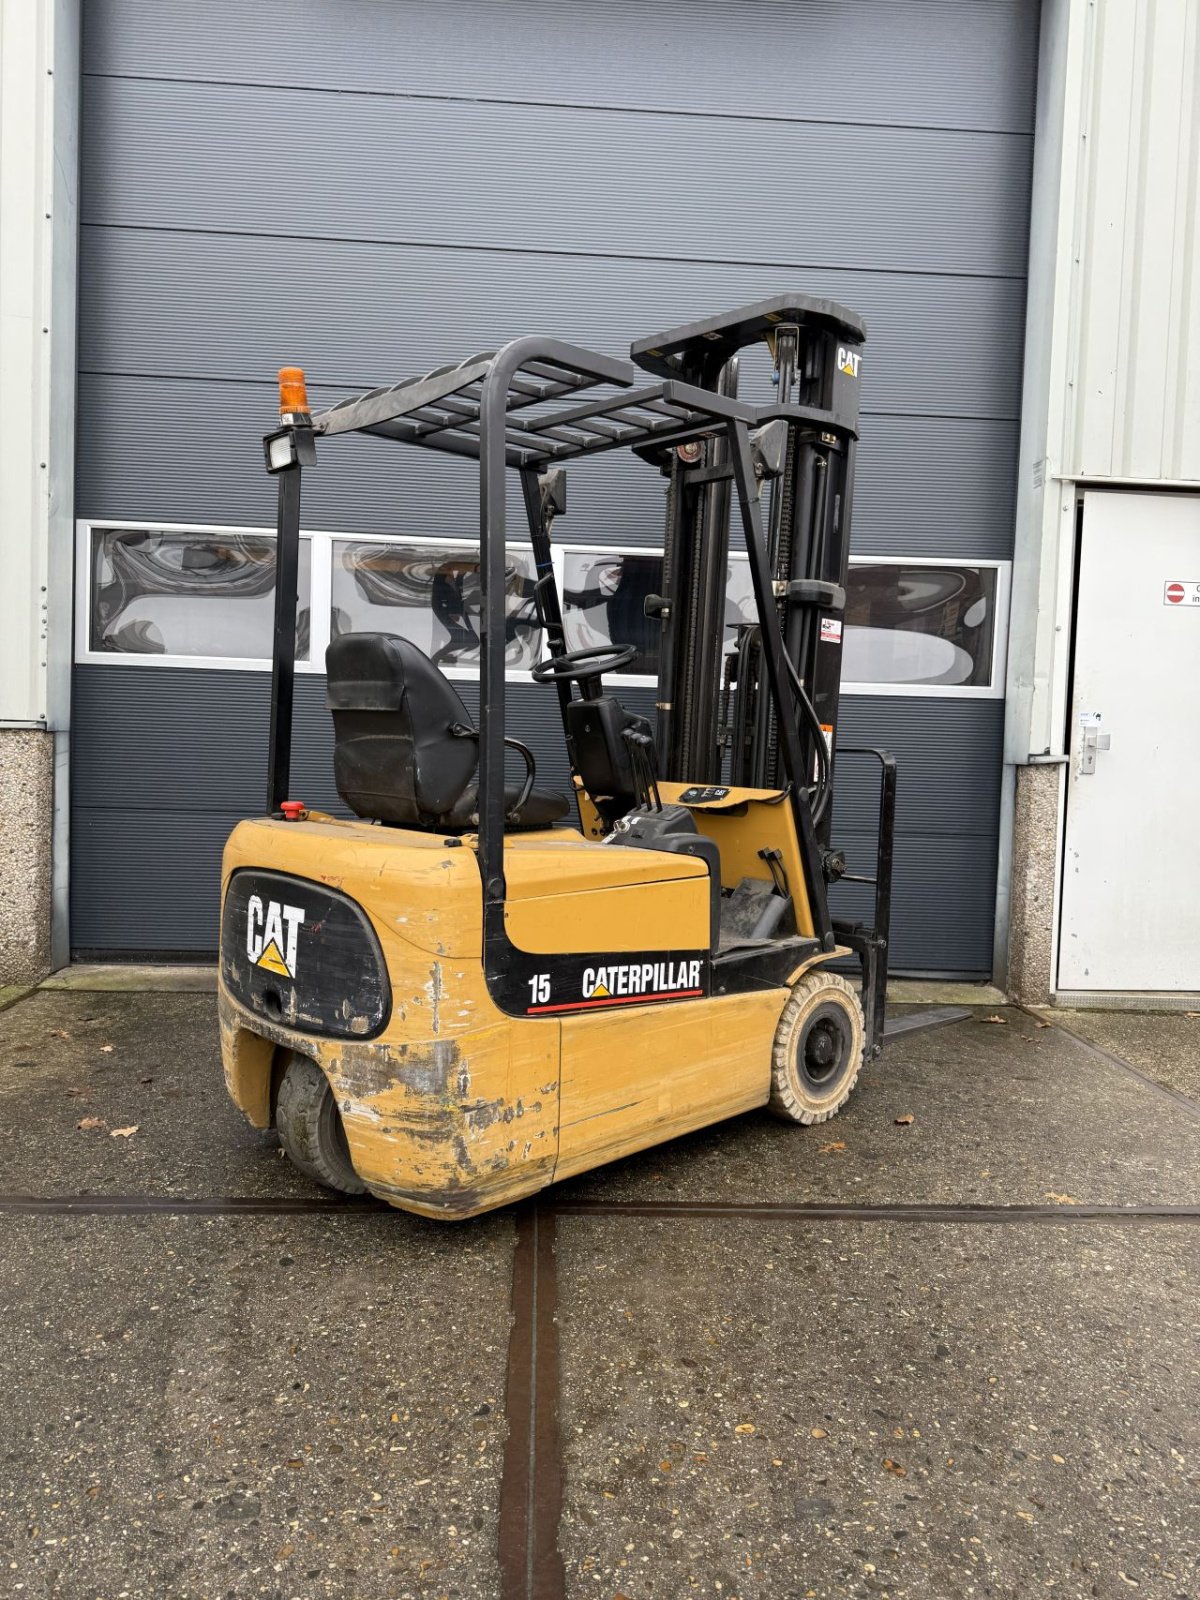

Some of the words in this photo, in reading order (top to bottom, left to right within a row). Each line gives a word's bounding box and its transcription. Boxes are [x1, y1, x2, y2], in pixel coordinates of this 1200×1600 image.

[837, 347, 862, 377] CAT
[246, 894, 305, 979] CAT
[528, 973, 551, 1004] 15
[582, 960, 701, 999] CATERPILLAR
